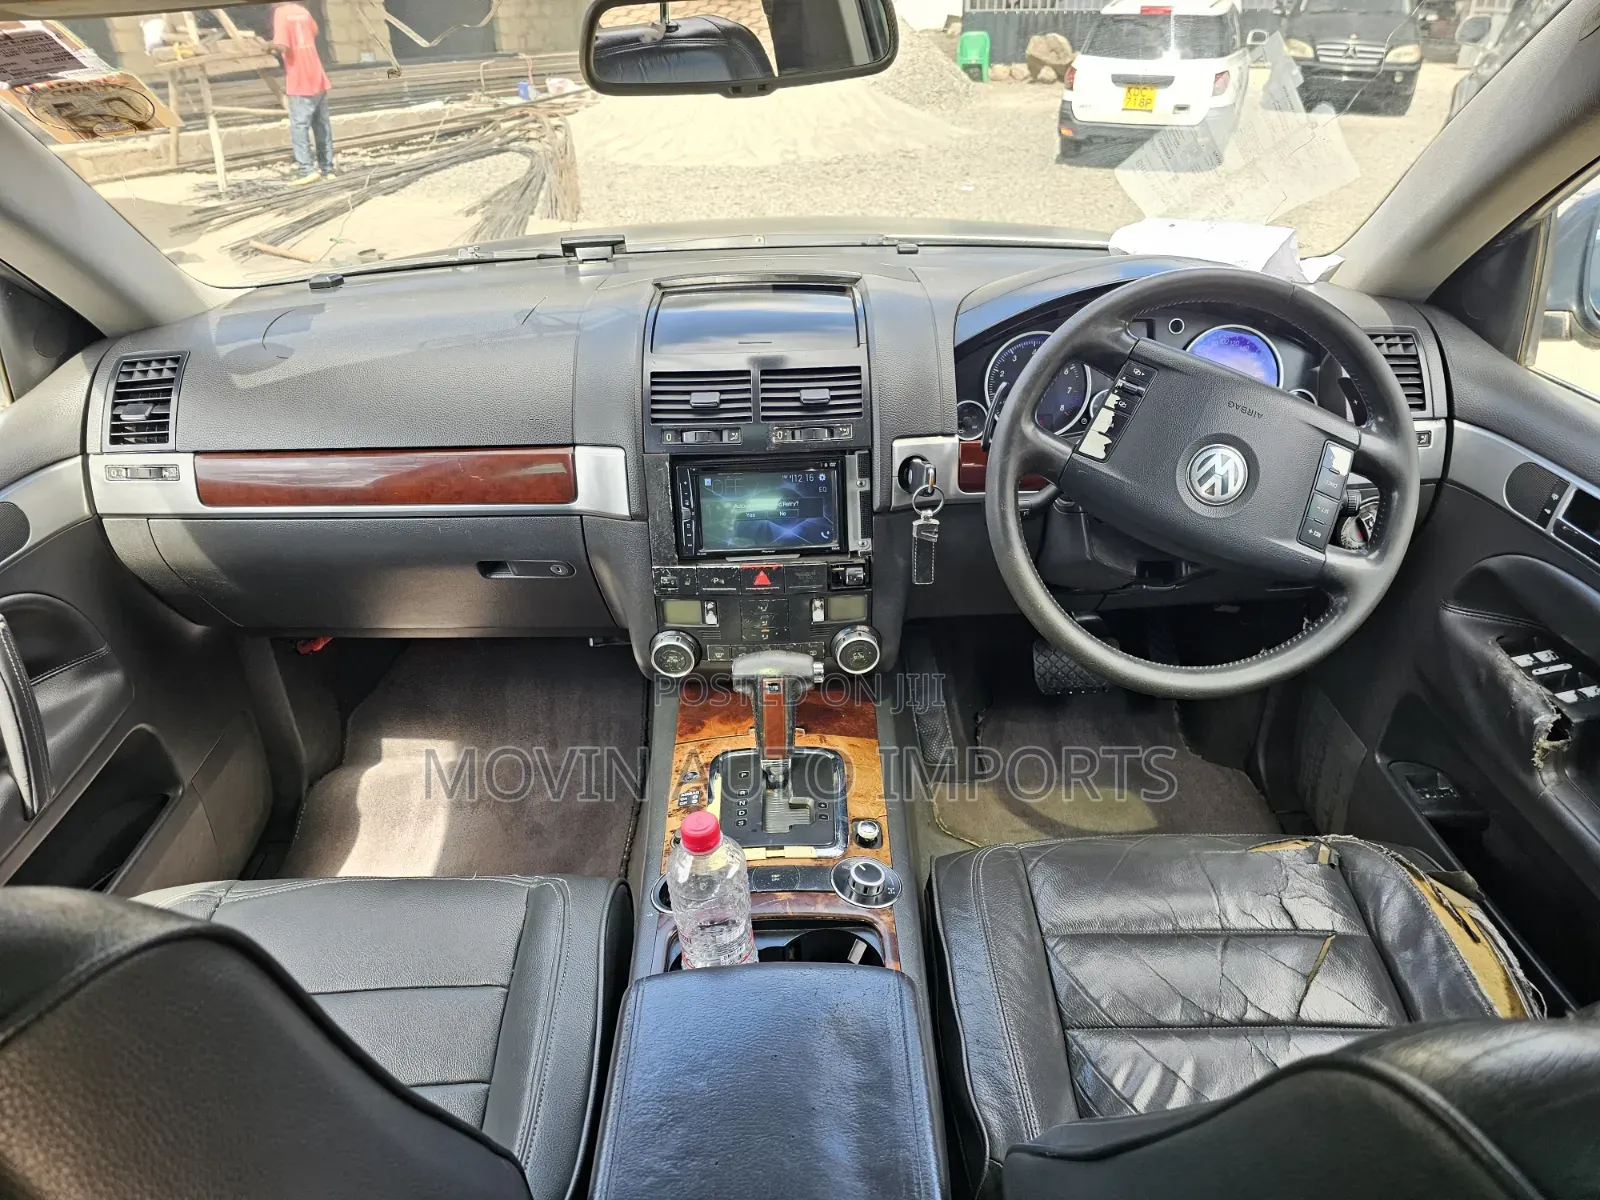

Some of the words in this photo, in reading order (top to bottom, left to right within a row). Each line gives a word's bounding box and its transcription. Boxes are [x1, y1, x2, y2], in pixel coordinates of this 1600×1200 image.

[1125, 98, 1152, 109] 718P
[1066, 386, 1072, 394] 7
[1227, 400, 1264, 419] AIRBAG
